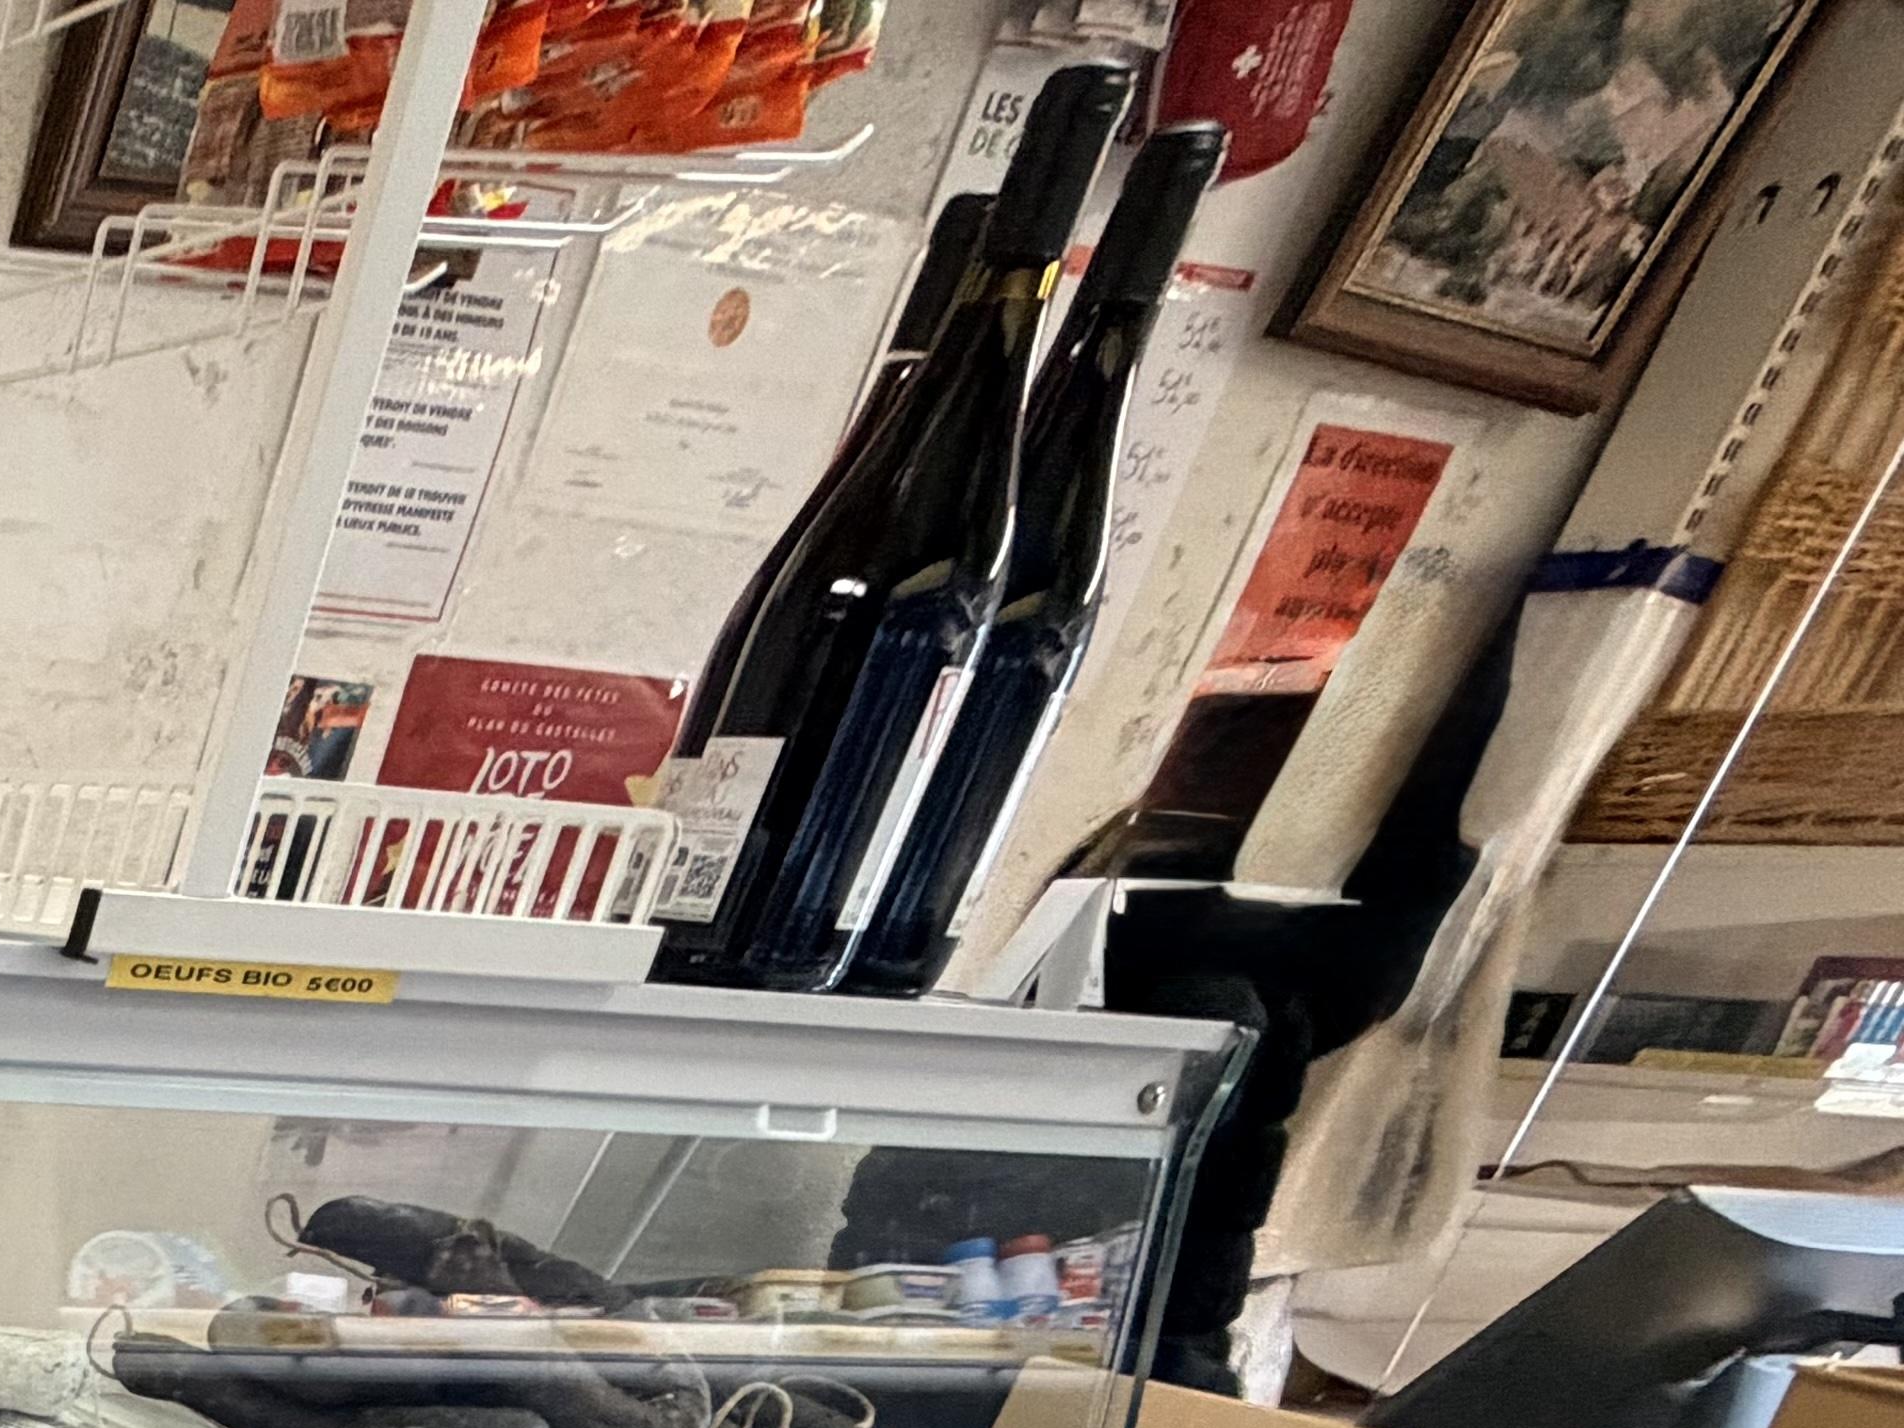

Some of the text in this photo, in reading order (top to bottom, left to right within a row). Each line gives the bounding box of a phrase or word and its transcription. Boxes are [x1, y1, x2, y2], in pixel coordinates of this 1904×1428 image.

[130, 964, 373, 993] OEUFS BIO 5€00
